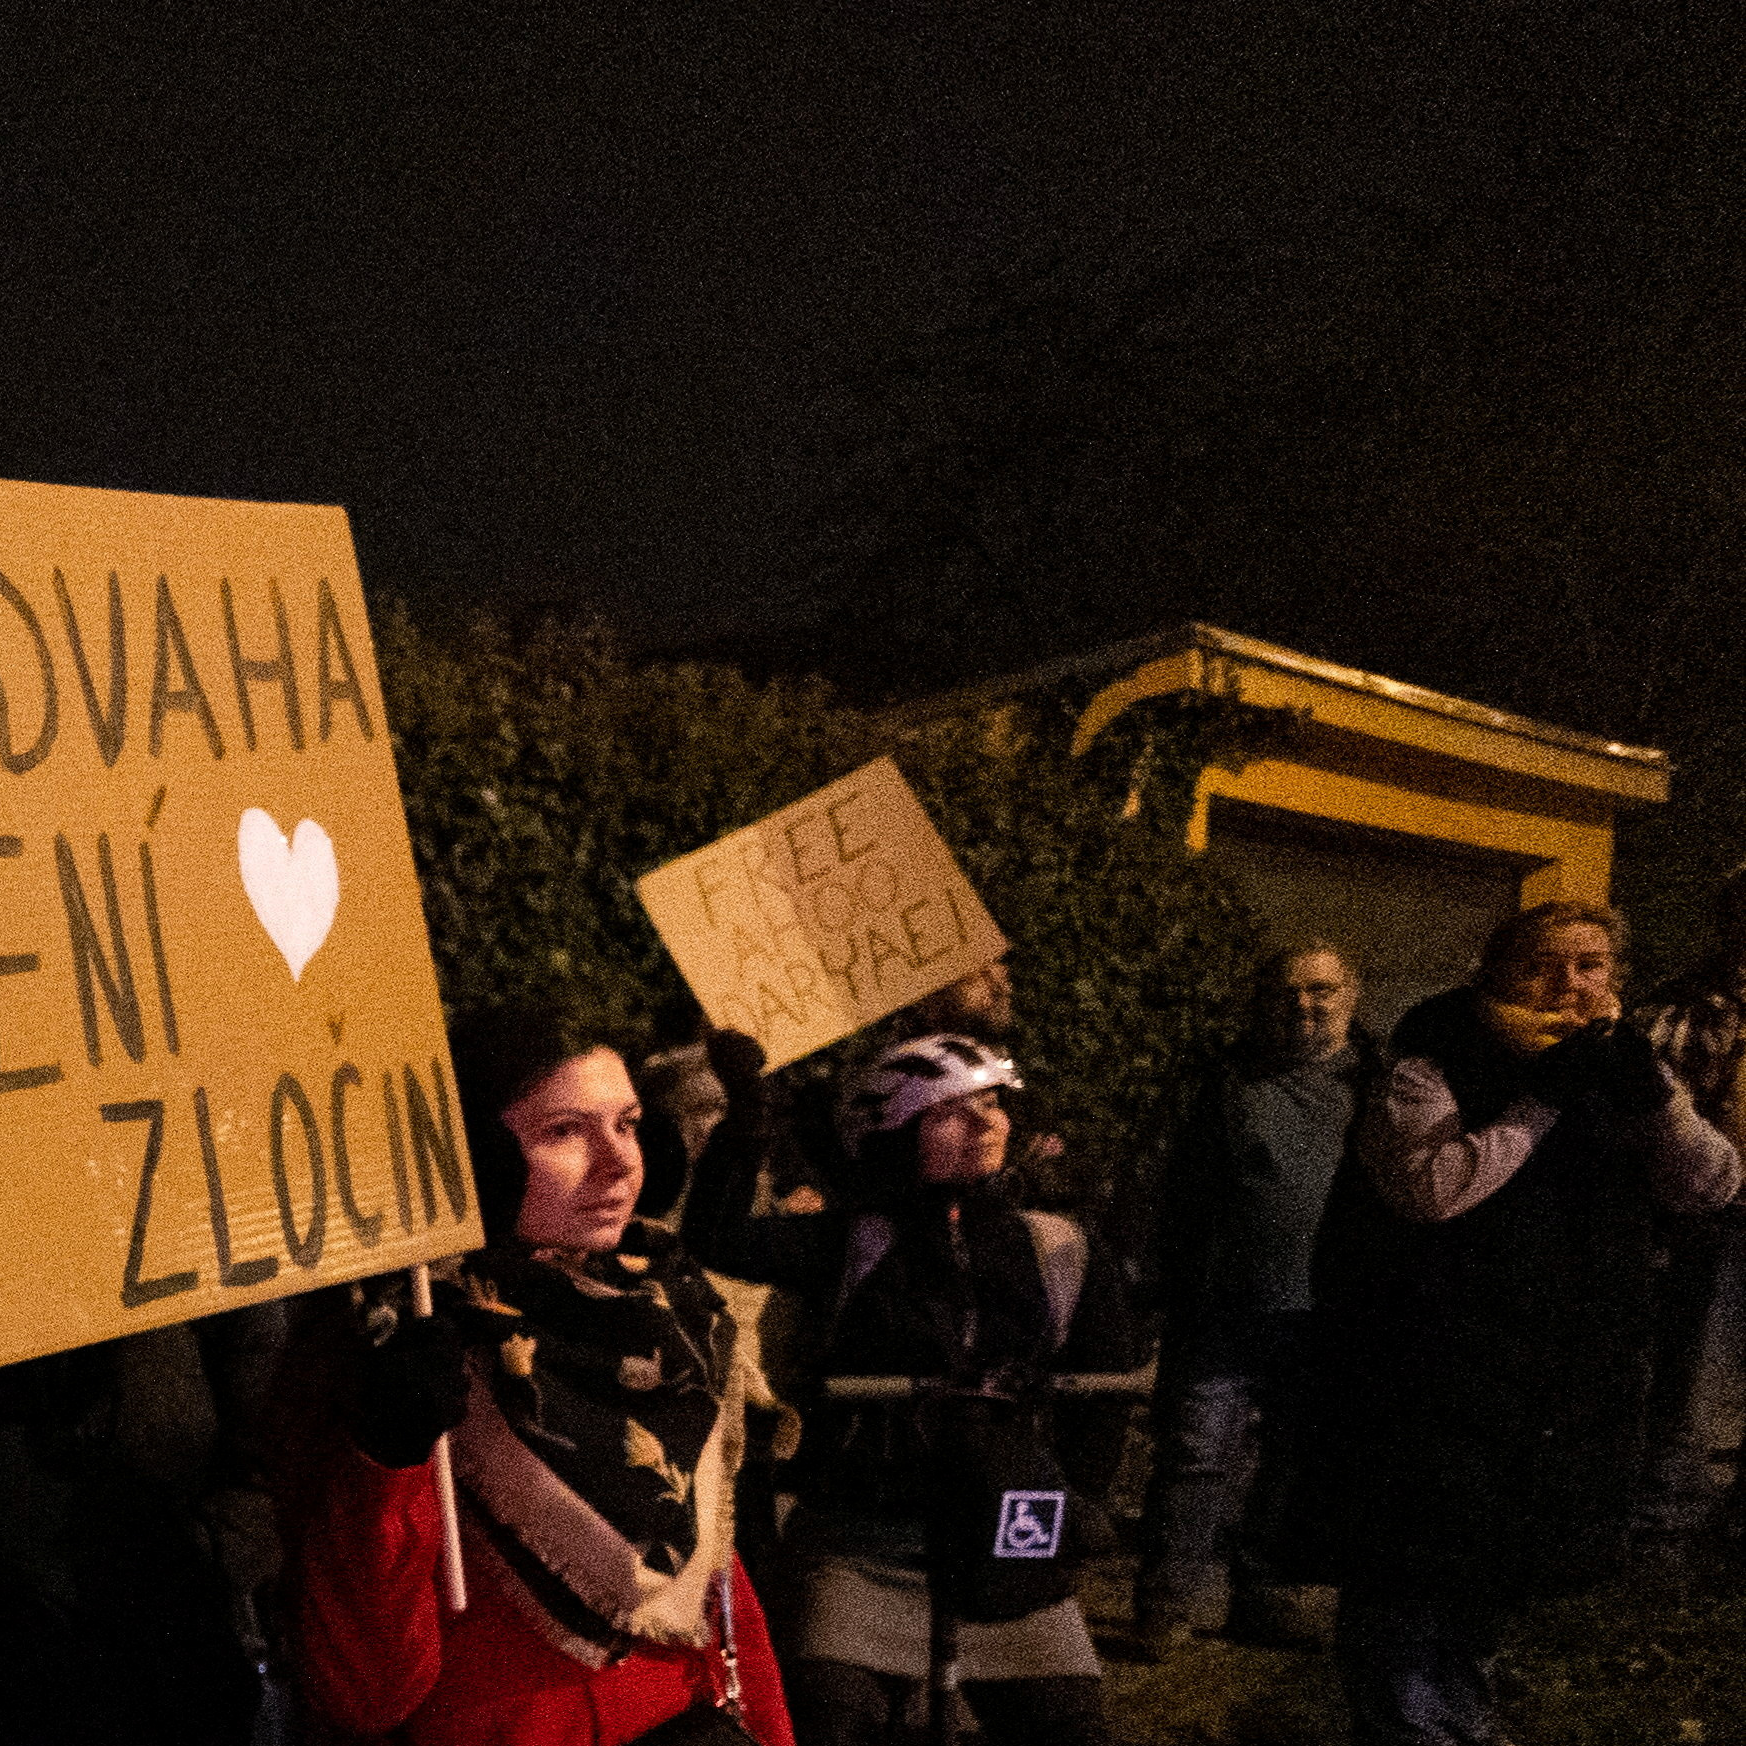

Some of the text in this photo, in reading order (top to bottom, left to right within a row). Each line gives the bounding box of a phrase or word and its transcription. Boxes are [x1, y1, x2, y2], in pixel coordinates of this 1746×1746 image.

[695, 789, 877, 928] FREE
[733, 863, 900, 981] AHOO
[99, 1012, 466, 1309] ZLOČIN
